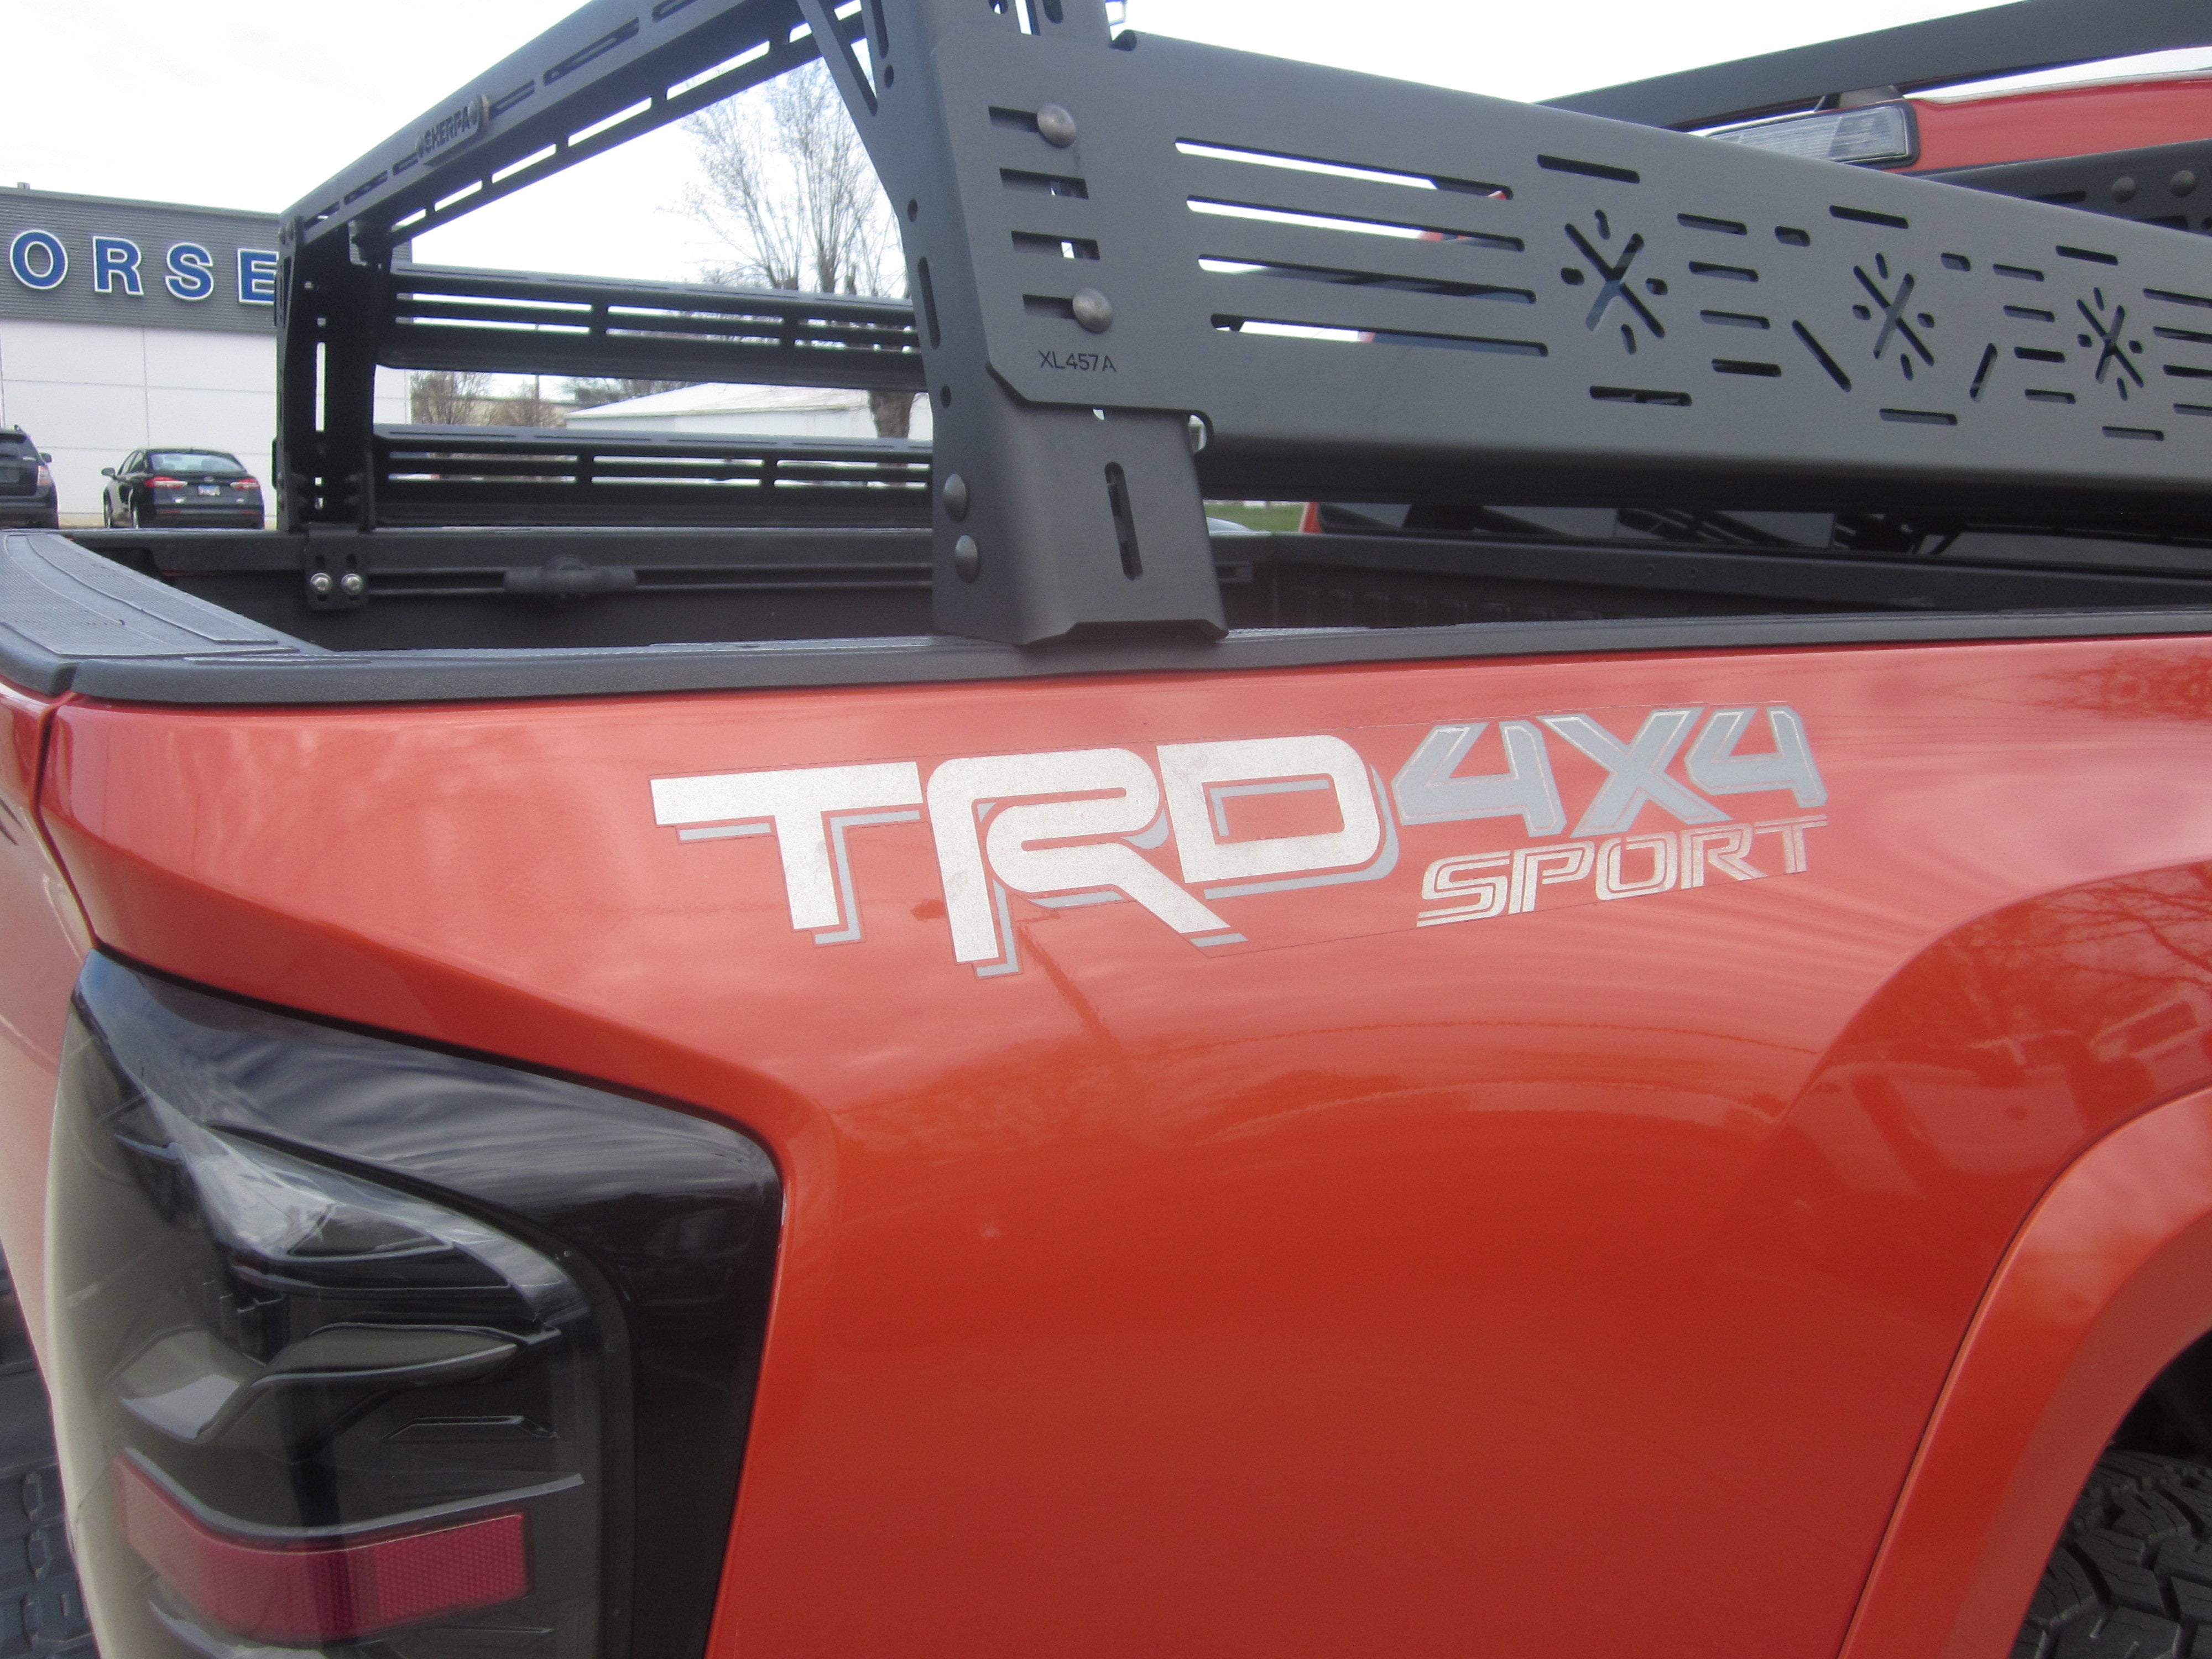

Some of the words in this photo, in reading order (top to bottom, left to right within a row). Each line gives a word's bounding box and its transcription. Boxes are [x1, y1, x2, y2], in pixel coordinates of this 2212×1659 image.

[424, 106, 470, 154] SHERPA
[9, 229, 278, 305] ORSE
[1038, 349, 1117, 372] XL457A
[650, 734, 1399, 978] TRD
[1416, 814, 1828, 927] SPORT
